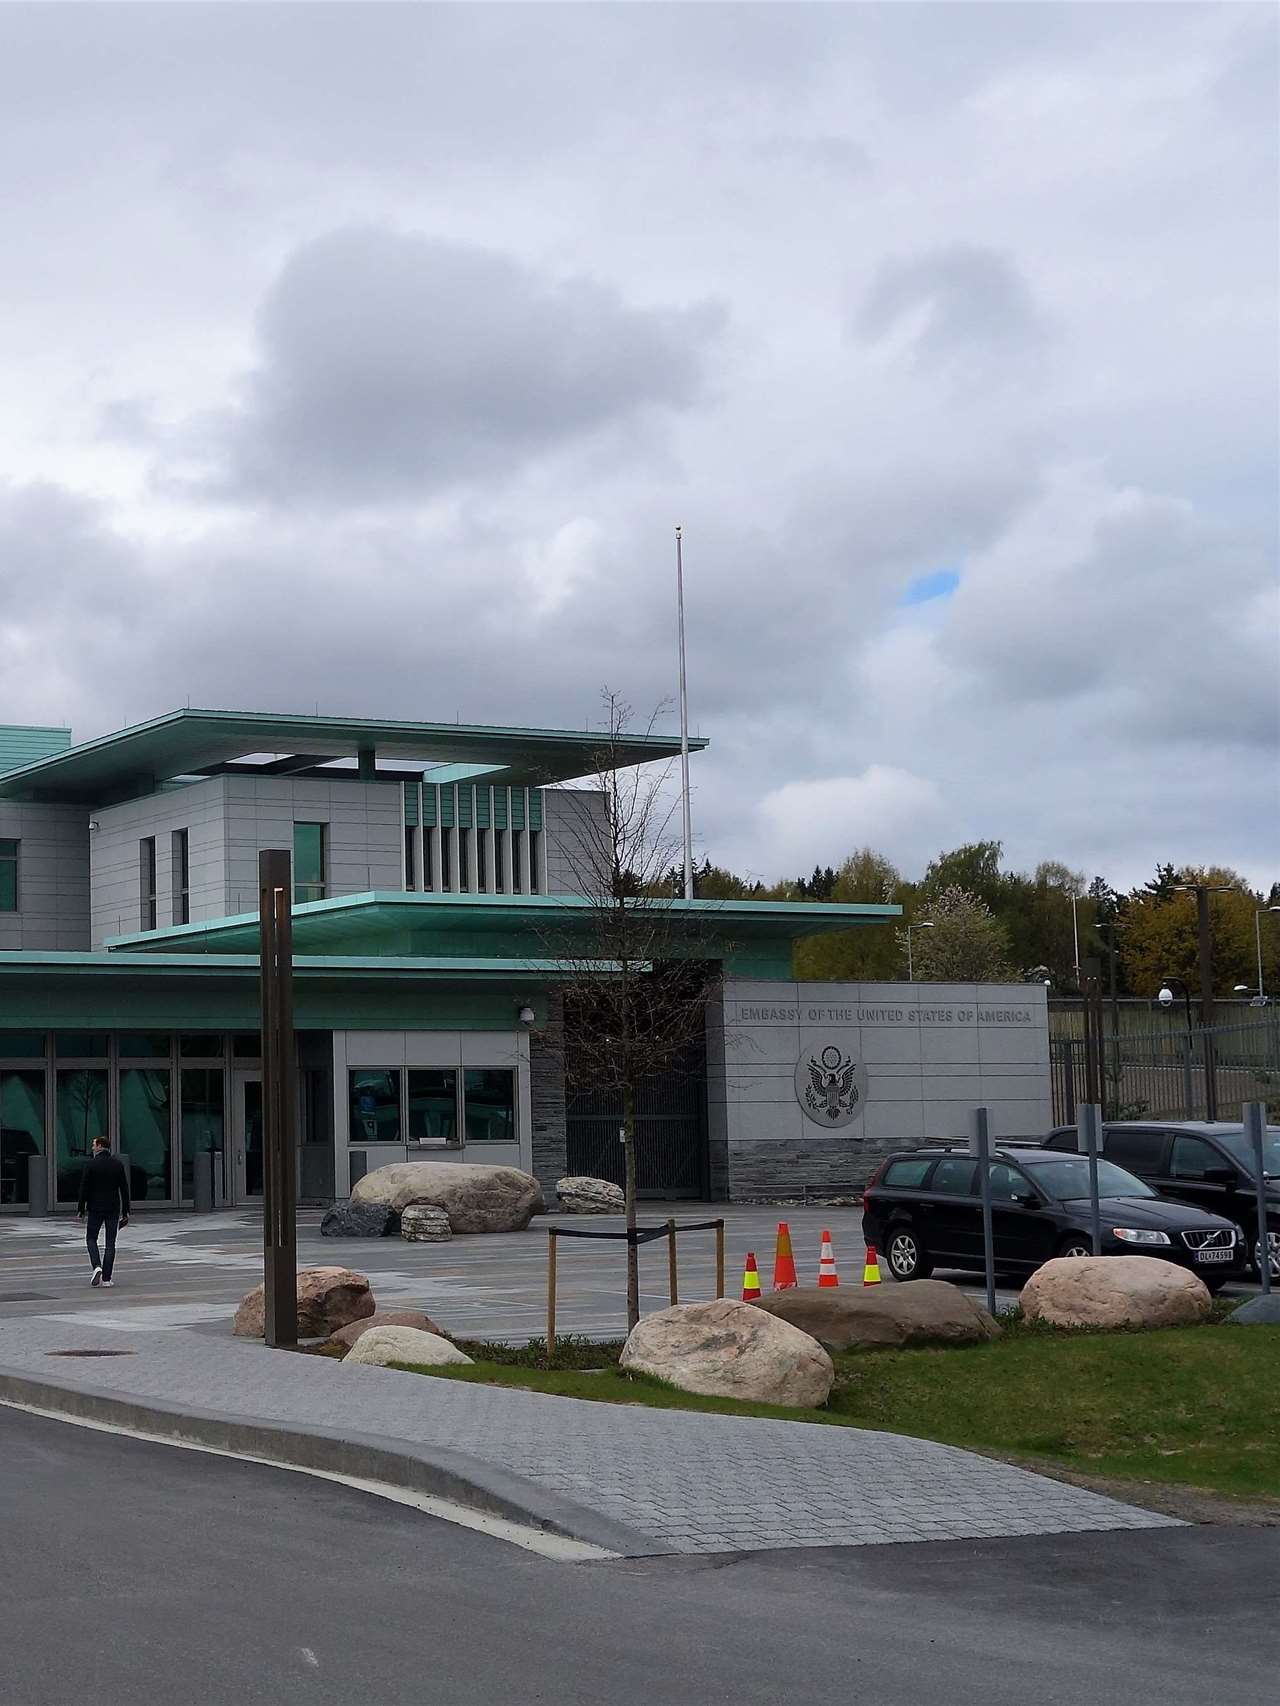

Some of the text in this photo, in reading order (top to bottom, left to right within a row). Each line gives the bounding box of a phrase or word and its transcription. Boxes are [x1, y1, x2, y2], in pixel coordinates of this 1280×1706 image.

[741, 1007, 1032, 1023] EMBASSY OF THE UNITED STATES OF AMERICA
